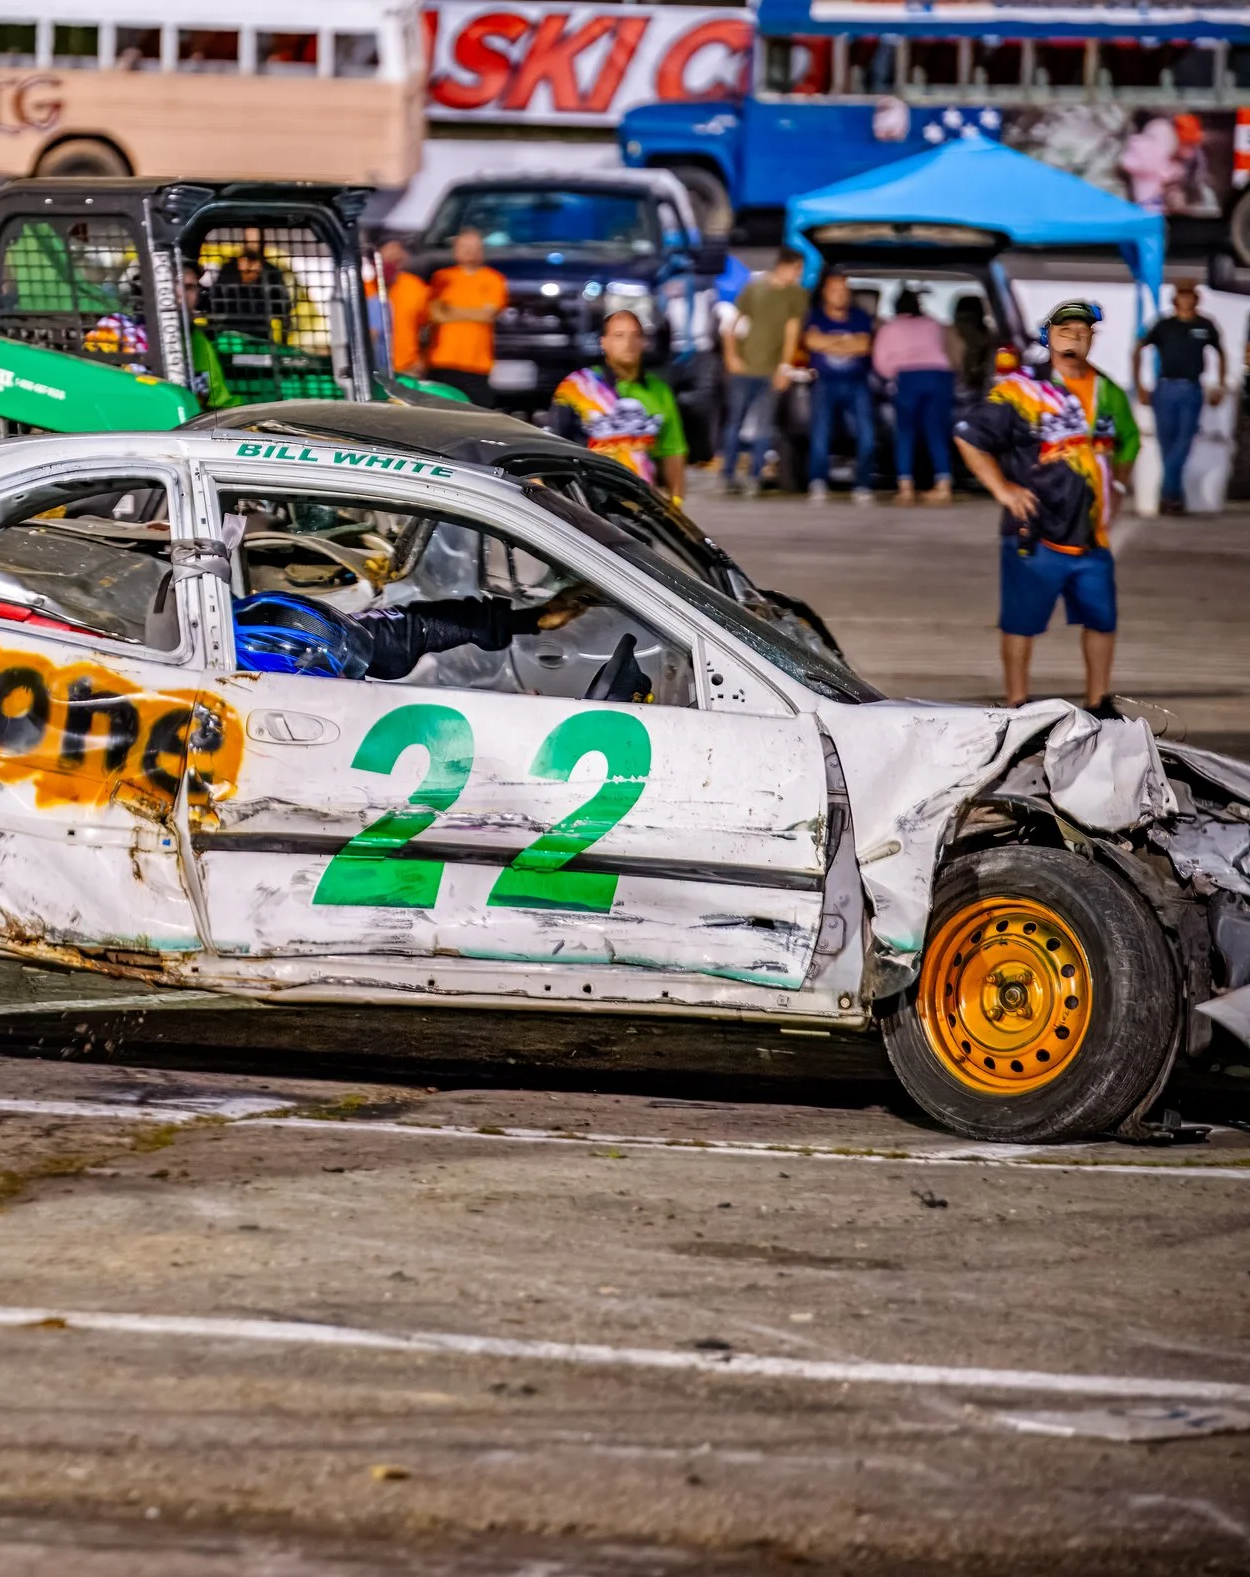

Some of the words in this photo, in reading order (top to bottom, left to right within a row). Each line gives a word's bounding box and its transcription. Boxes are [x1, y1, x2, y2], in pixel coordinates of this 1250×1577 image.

[236, 443, 319, 462] BILL
[333, 451, 455, 479] WHITE
[312, 703, 653, 914] 22
